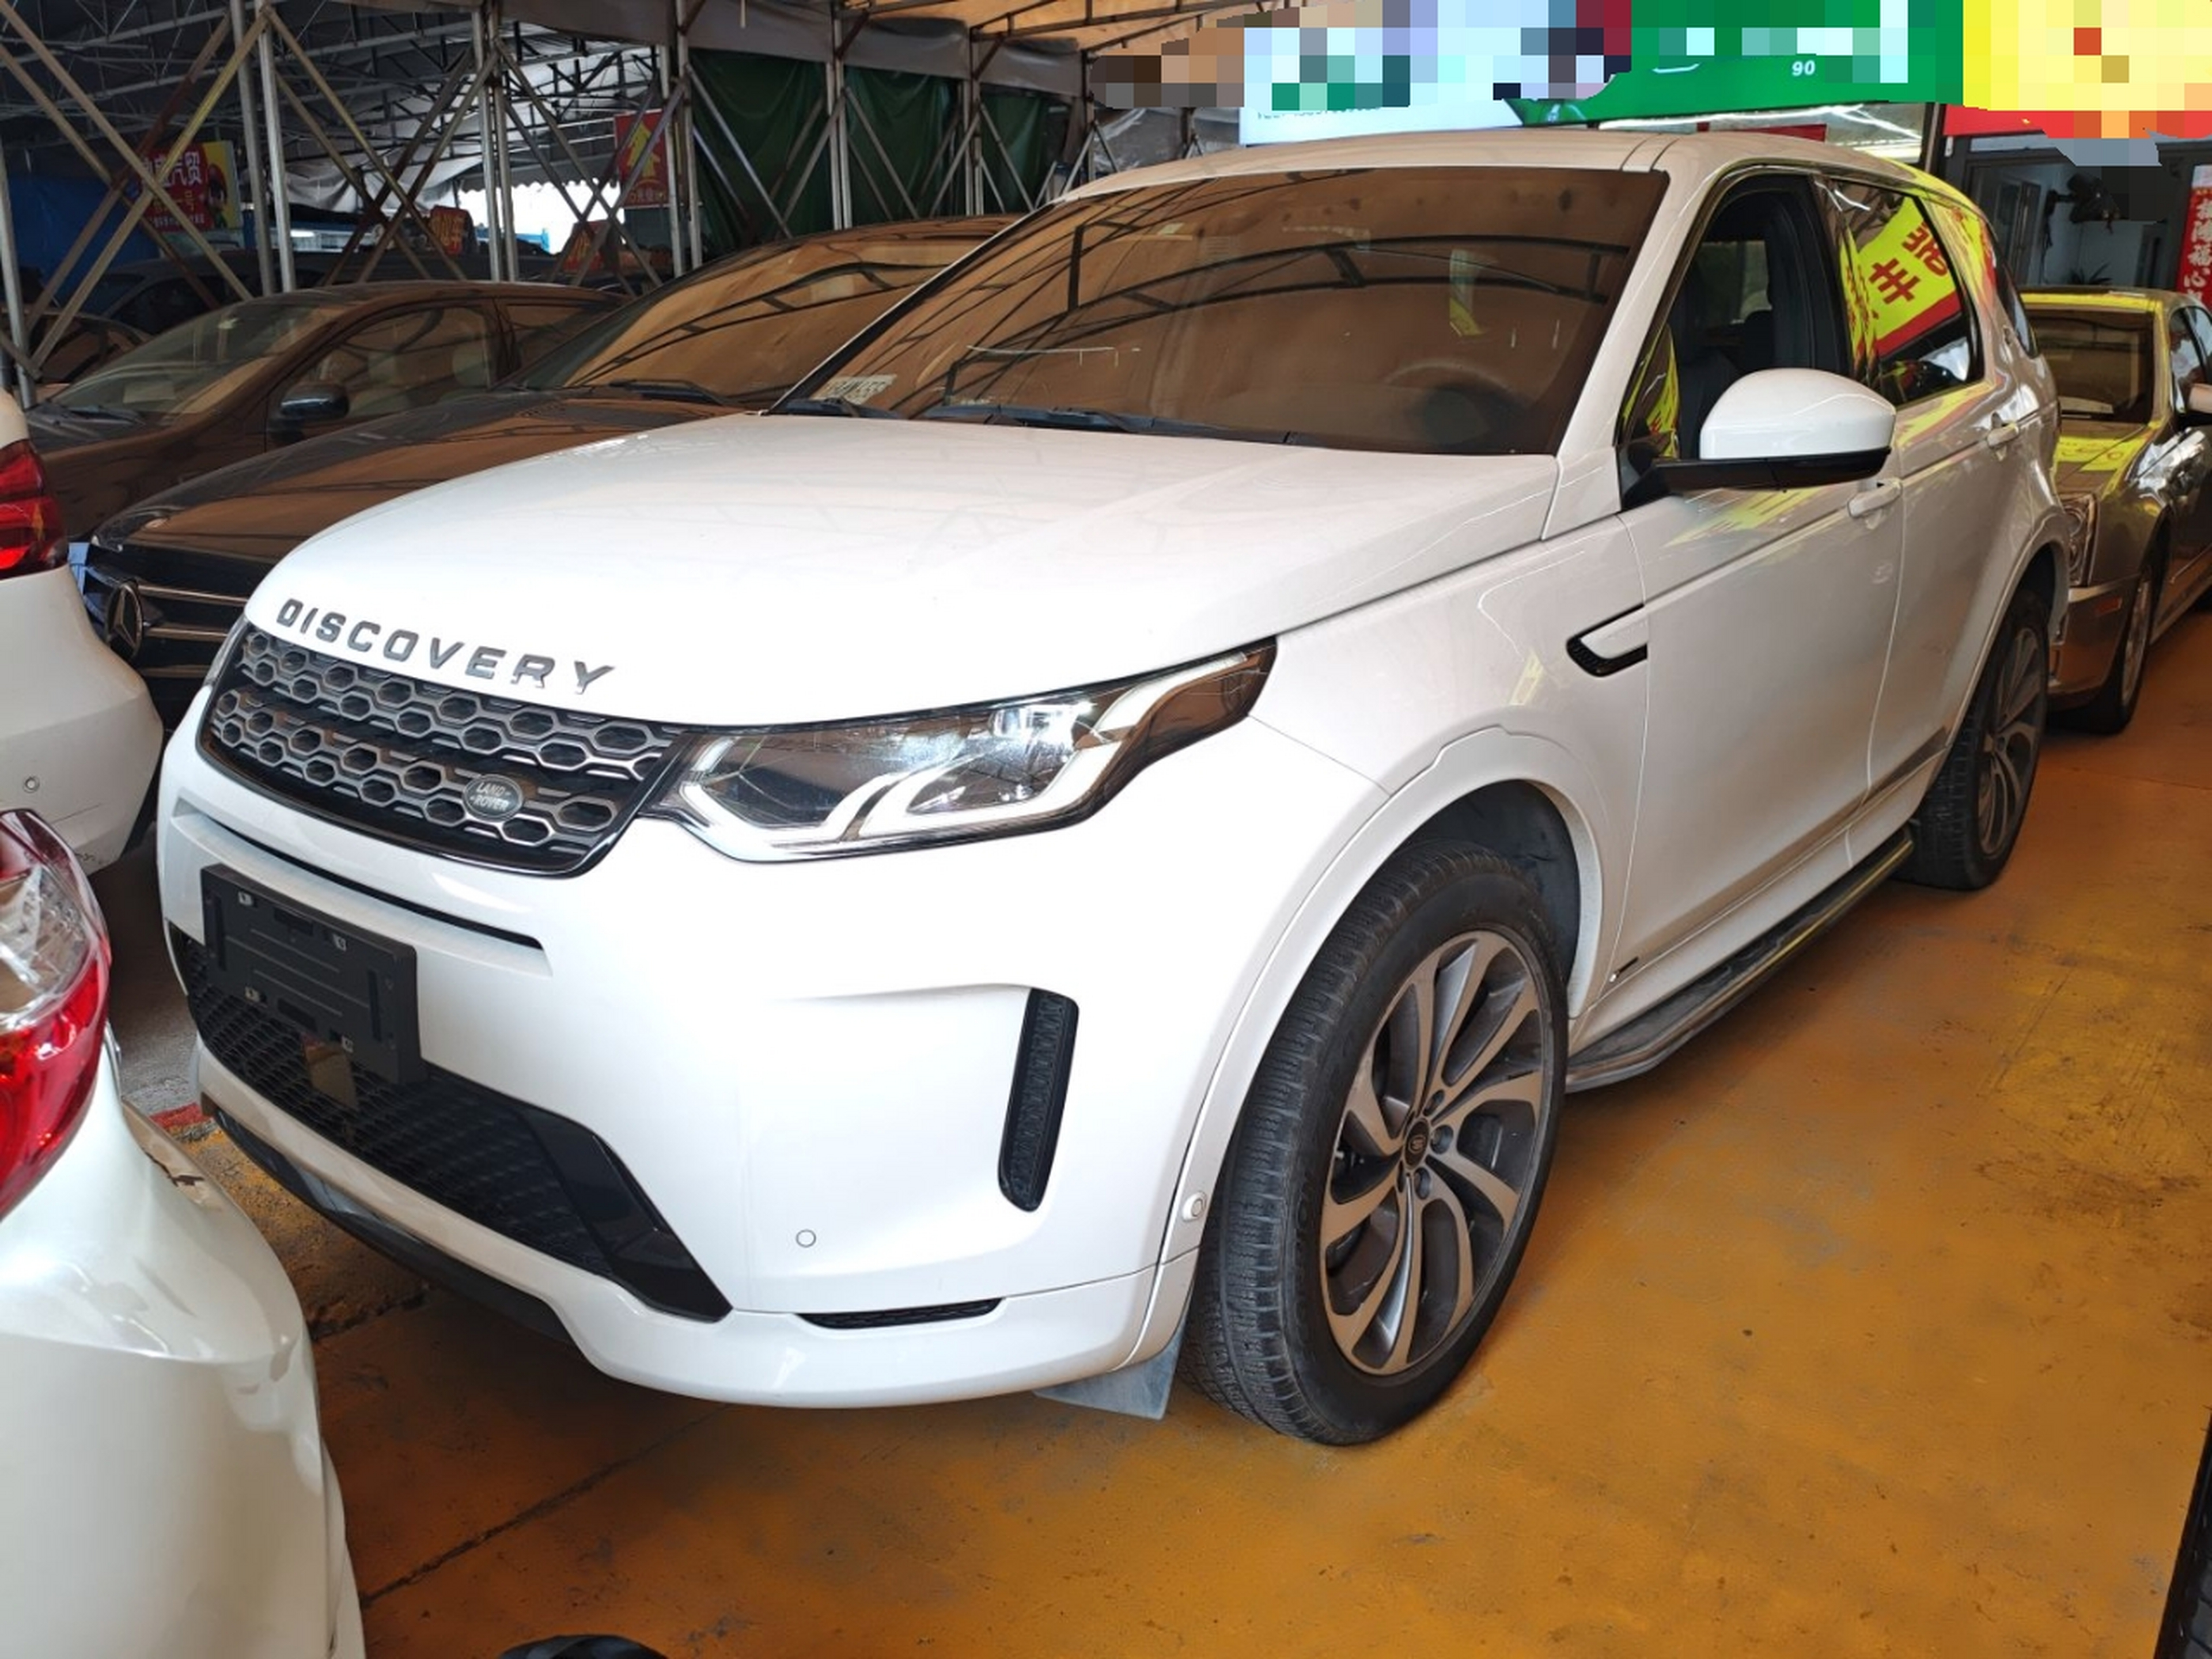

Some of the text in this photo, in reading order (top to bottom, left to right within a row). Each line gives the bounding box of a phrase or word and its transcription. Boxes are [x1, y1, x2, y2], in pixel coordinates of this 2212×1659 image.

[276, 599, 615, 694] DISCOVERY
[476, 782, 506, 797] LAND
[473, 794, 510, 811] ROVER
